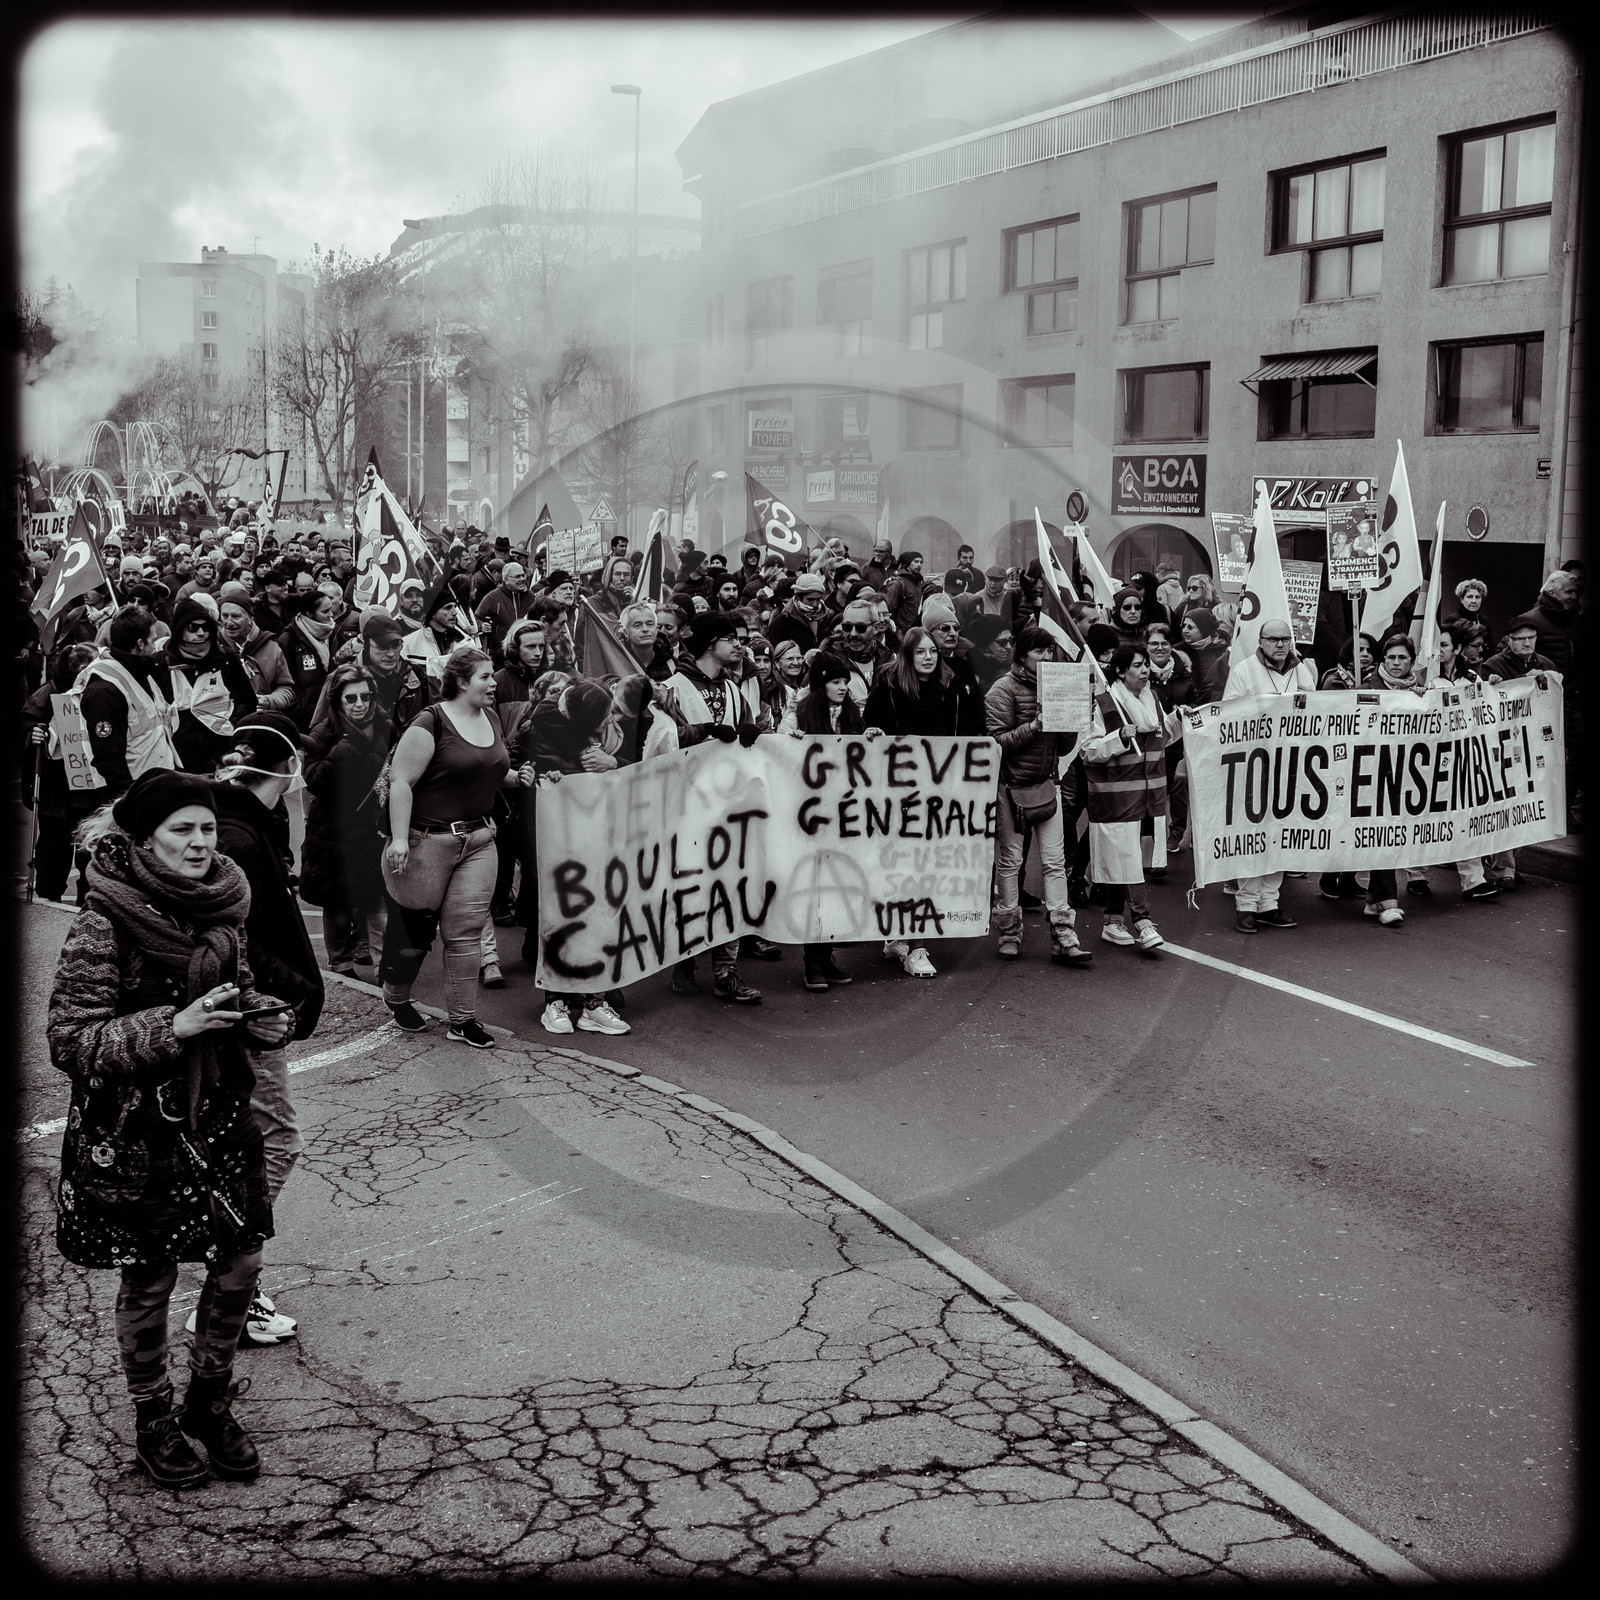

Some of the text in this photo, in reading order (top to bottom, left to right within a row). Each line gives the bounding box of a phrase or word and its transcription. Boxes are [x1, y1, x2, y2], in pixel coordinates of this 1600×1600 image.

[754, 416, 790, 428] prink
[755, 433, 790, 446] TONER
[840, 471, 878, 485] CARTOUCHES
[1144, 458, 1198, 488] BCA
[808, 476, 834, 494] prink
[840, 490, 878, 504] IMPRIMANTES
[1144, 492, 1198, 502] ENVIRONNEMENT
[1118, 505, 1139, 513] Diagnostics
[52, 517, 65, 534] DE
[1220, 559, 1246, 568] DÉPEND
[1330, 557, 1377, 566] COMMENCE
[1220, 713, 1273, 744] SALARIÉS
[1380, 709, 1441, 735] RETRAITÉS
[1335, 746, 1345, 757] FO
[1221, 745, 1329, 826] TOUS
[1350, 730, 1516, 817] ENSEMBLE
[798, 789, 999, 840] GÉNÉRALE
[1214, 832, 1266, 859] SALAIRES
[1281, 829, 1331, 850] EMPLOI
[1354, 825, 1406, 848] SERVICES
[1413, 821, 1453, 845] PUBLICS
[1469, 810, 1509, 838] PROTECTION
[1512, 800, 1546, 826] SOCIALE
[553, 809, 768, 918] BOULOT
[543, 876, 776, 983] CAVEAU
